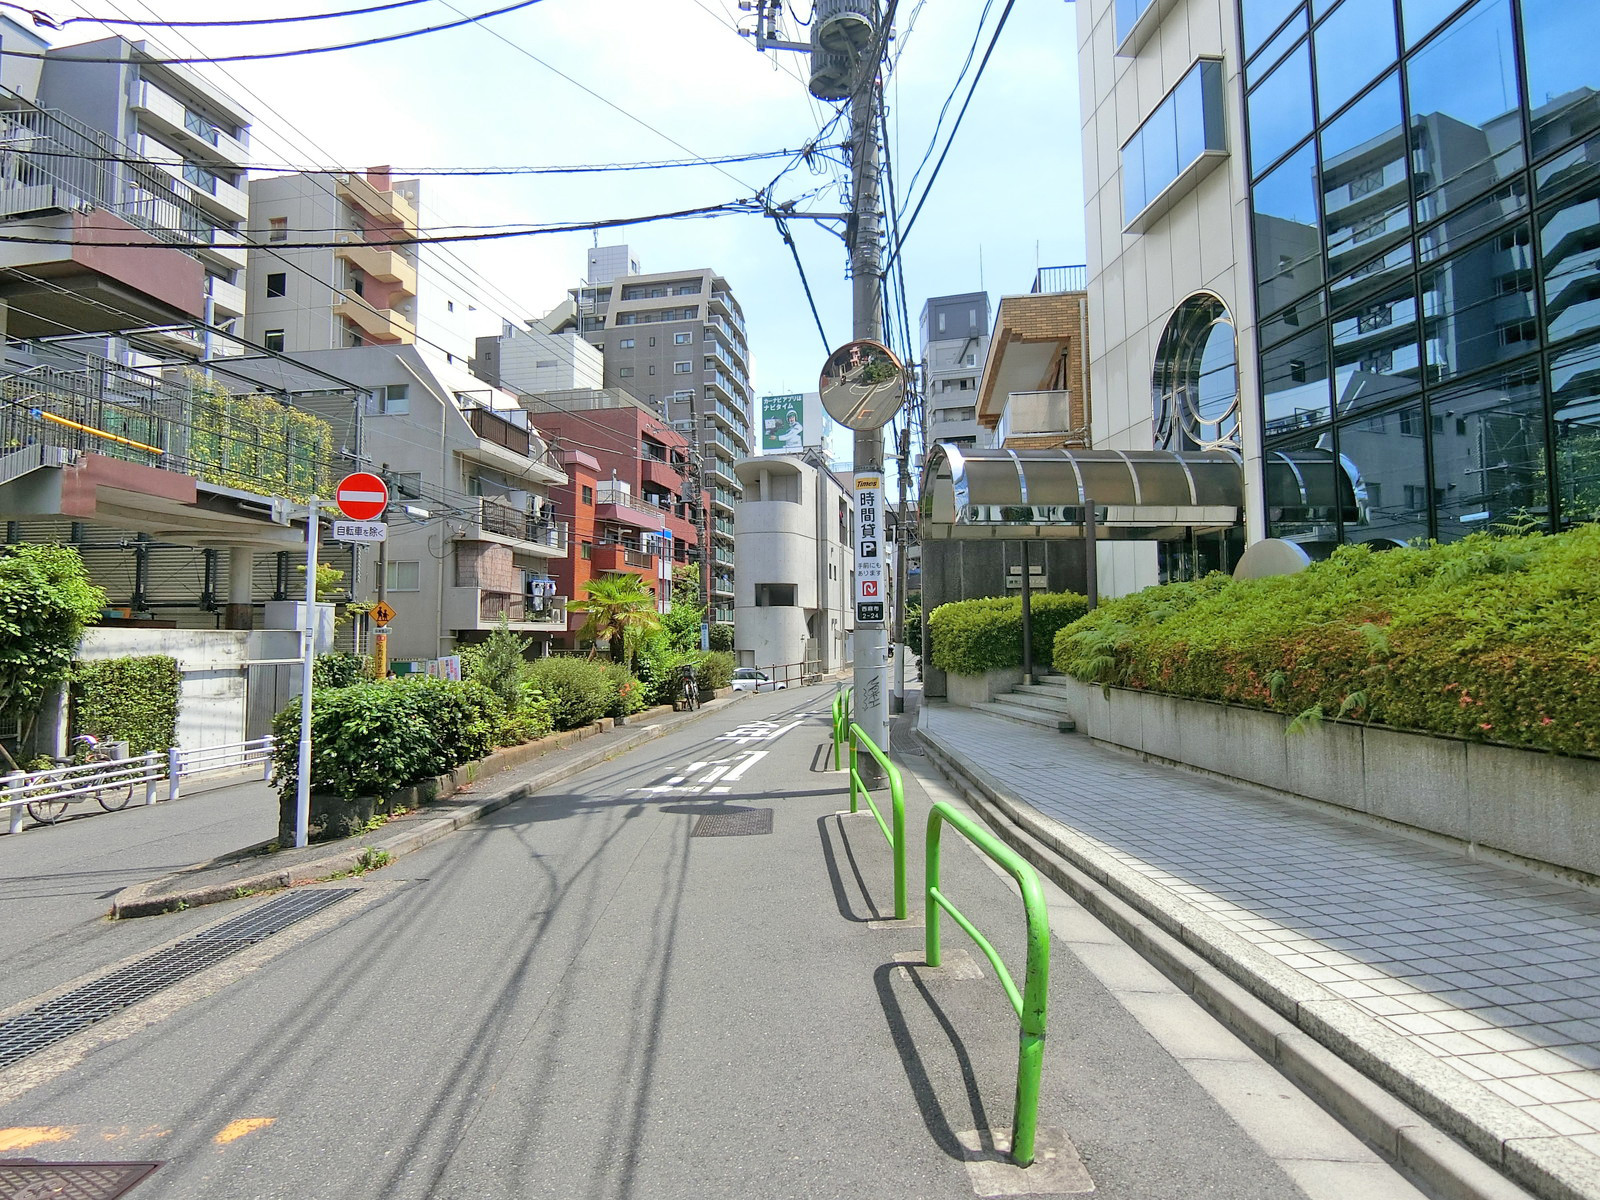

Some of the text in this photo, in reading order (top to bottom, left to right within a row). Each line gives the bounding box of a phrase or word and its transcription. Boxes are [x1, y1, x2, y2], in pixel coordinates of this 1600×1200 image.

[764, 403, 793, 411] ナビタイム
[856, 480, 878, 488] Times
[860, 491, 876, 557] 時間貸 P
[337, 526, 384, 537] 自転車を除く
